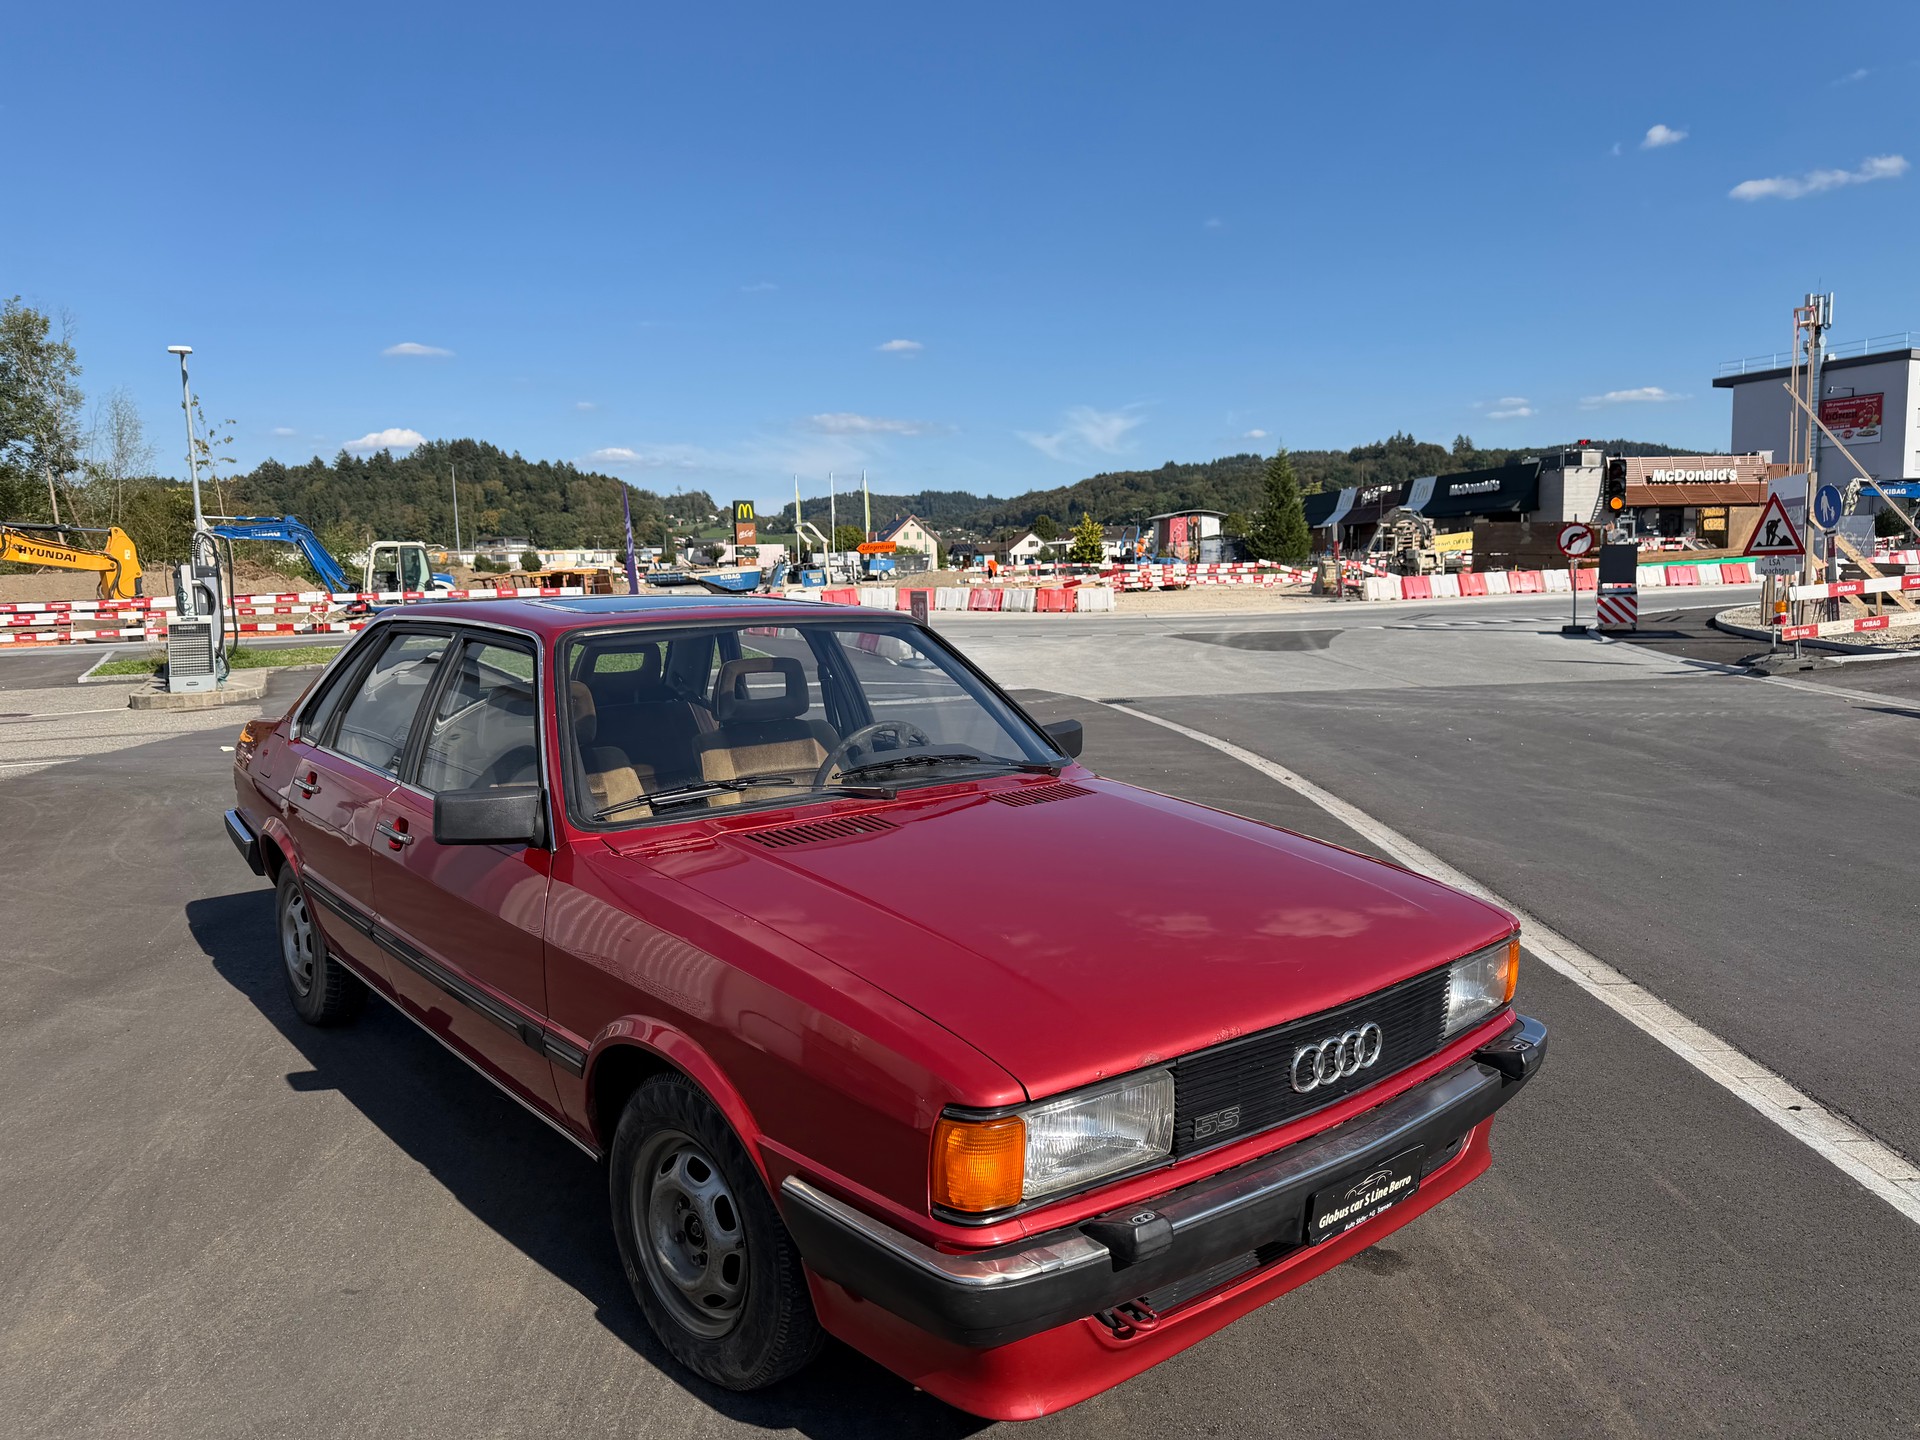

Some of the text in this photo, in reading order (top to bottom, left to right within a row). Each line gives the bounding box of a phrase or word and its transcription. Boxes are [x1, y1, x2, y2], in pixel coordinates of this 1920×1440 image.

[1652, 468, 1737, 482] McDonald's
[1449, 480, 1500, 496] McDonald's
[18, 544, 77, 563] HYUNDAI
[1761, 567, 1789, 575] beachten
[1837, 585, 1856, 593] KIBAG
[1194, 1106, 1239, 1139] 5S
[1319, 1175, 1411, 1228] Globus car S Line Berro
